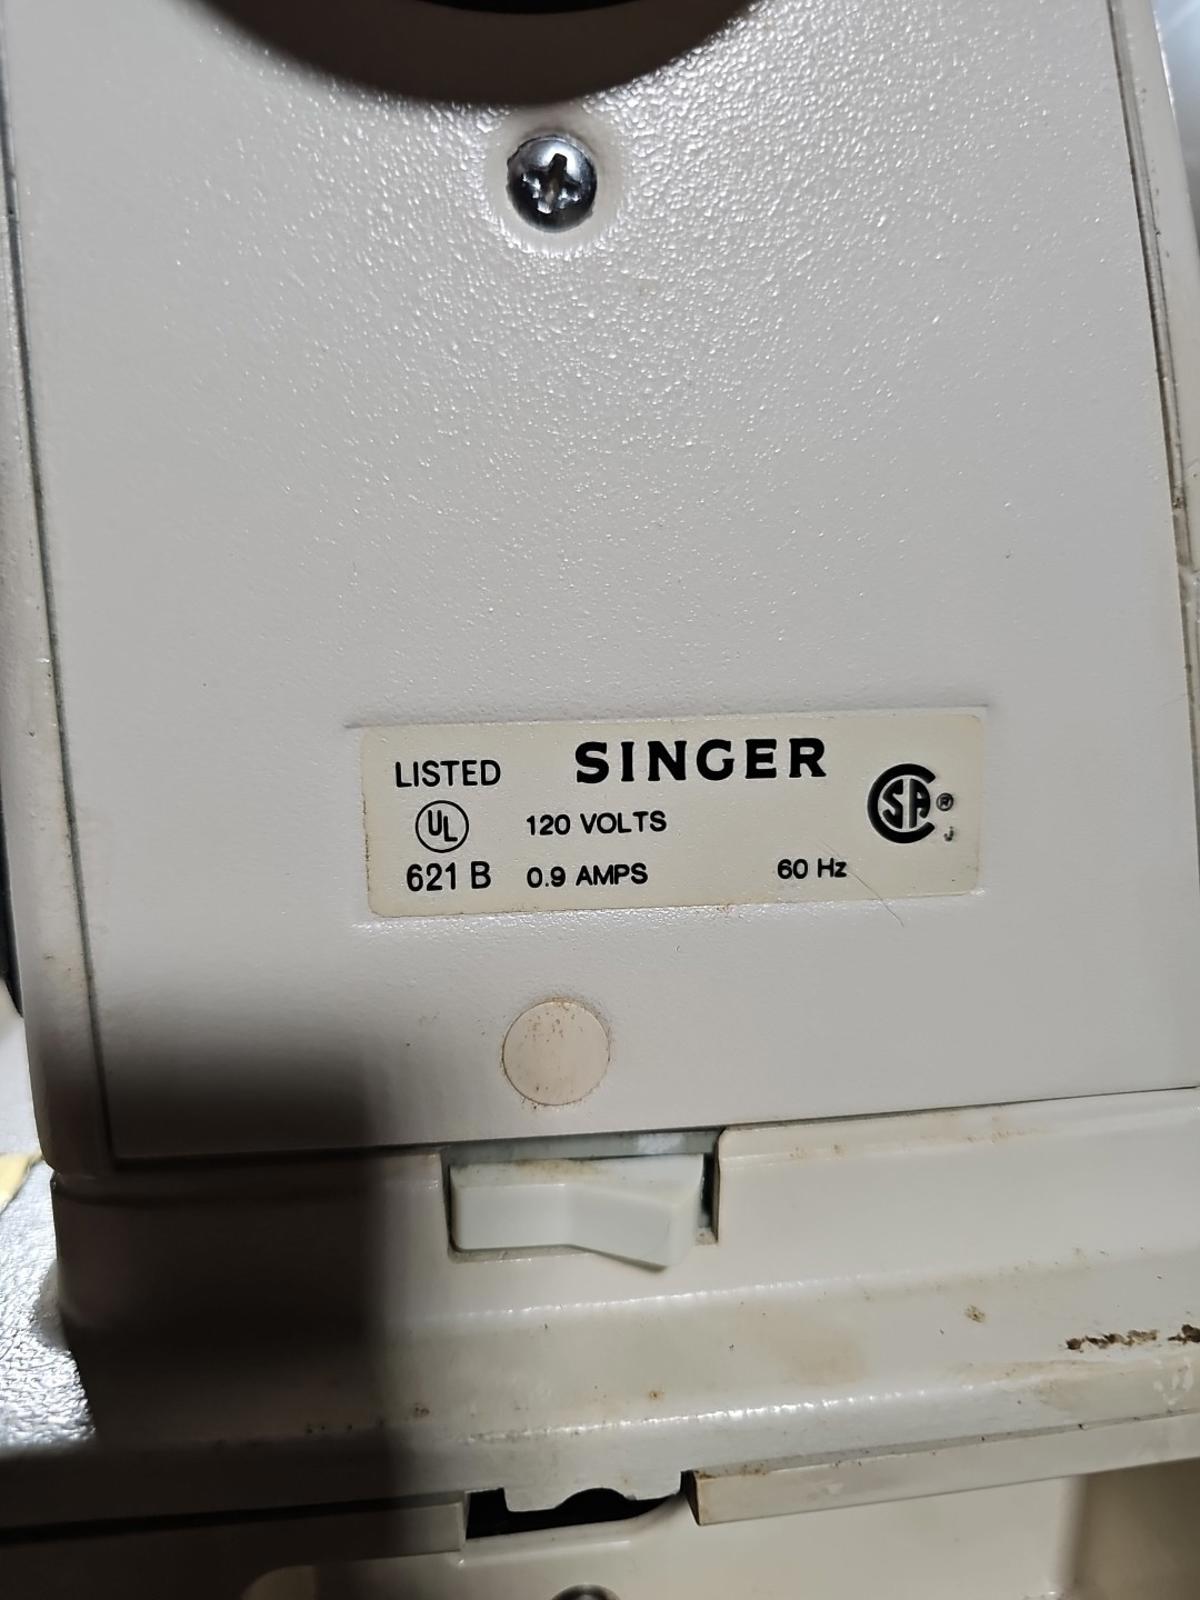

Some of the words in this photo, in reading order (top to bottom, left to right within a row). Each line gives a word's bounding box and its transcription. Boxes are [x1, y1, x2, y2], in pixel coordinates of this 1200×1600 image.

[394, 758, 502, 789] LISTED
[574, 737, 827, 785] SINGER
[427, 810, 459, 843] UL
[526, 813, 571, 836] 120
[581, 809, 668, 835] VOLTS
[406, 862, 457, 893] 621
[470, 860, 492, 890] B
[526, 864, 567, 889] 0.9
[575, 861, 650, 887] AMPS
[777, 858, 809, 880] 60
[817, 857, 848, 879] Hz
